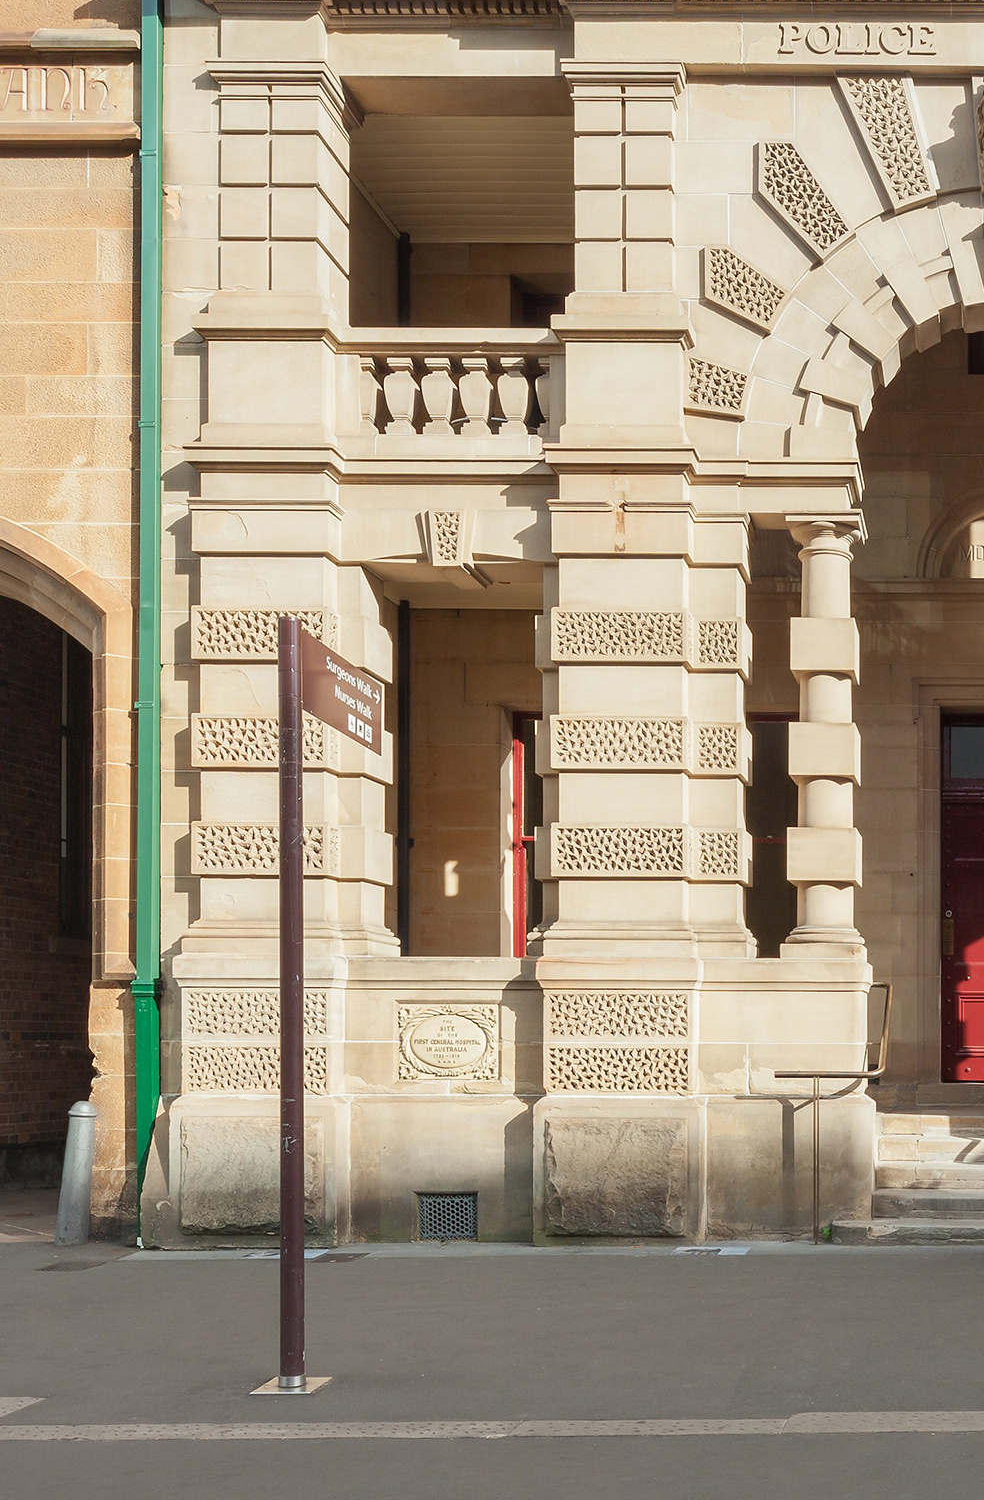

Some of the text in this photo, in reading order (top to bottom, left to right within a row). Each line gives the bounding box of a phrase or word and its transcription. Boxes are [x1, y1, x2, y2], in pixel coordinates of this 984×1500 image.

[777, 23, 937, 56] POLICE
[326, 656, 372, 699] Surgeons Walk
[335, 684, 372, 720] Nurses Walk
